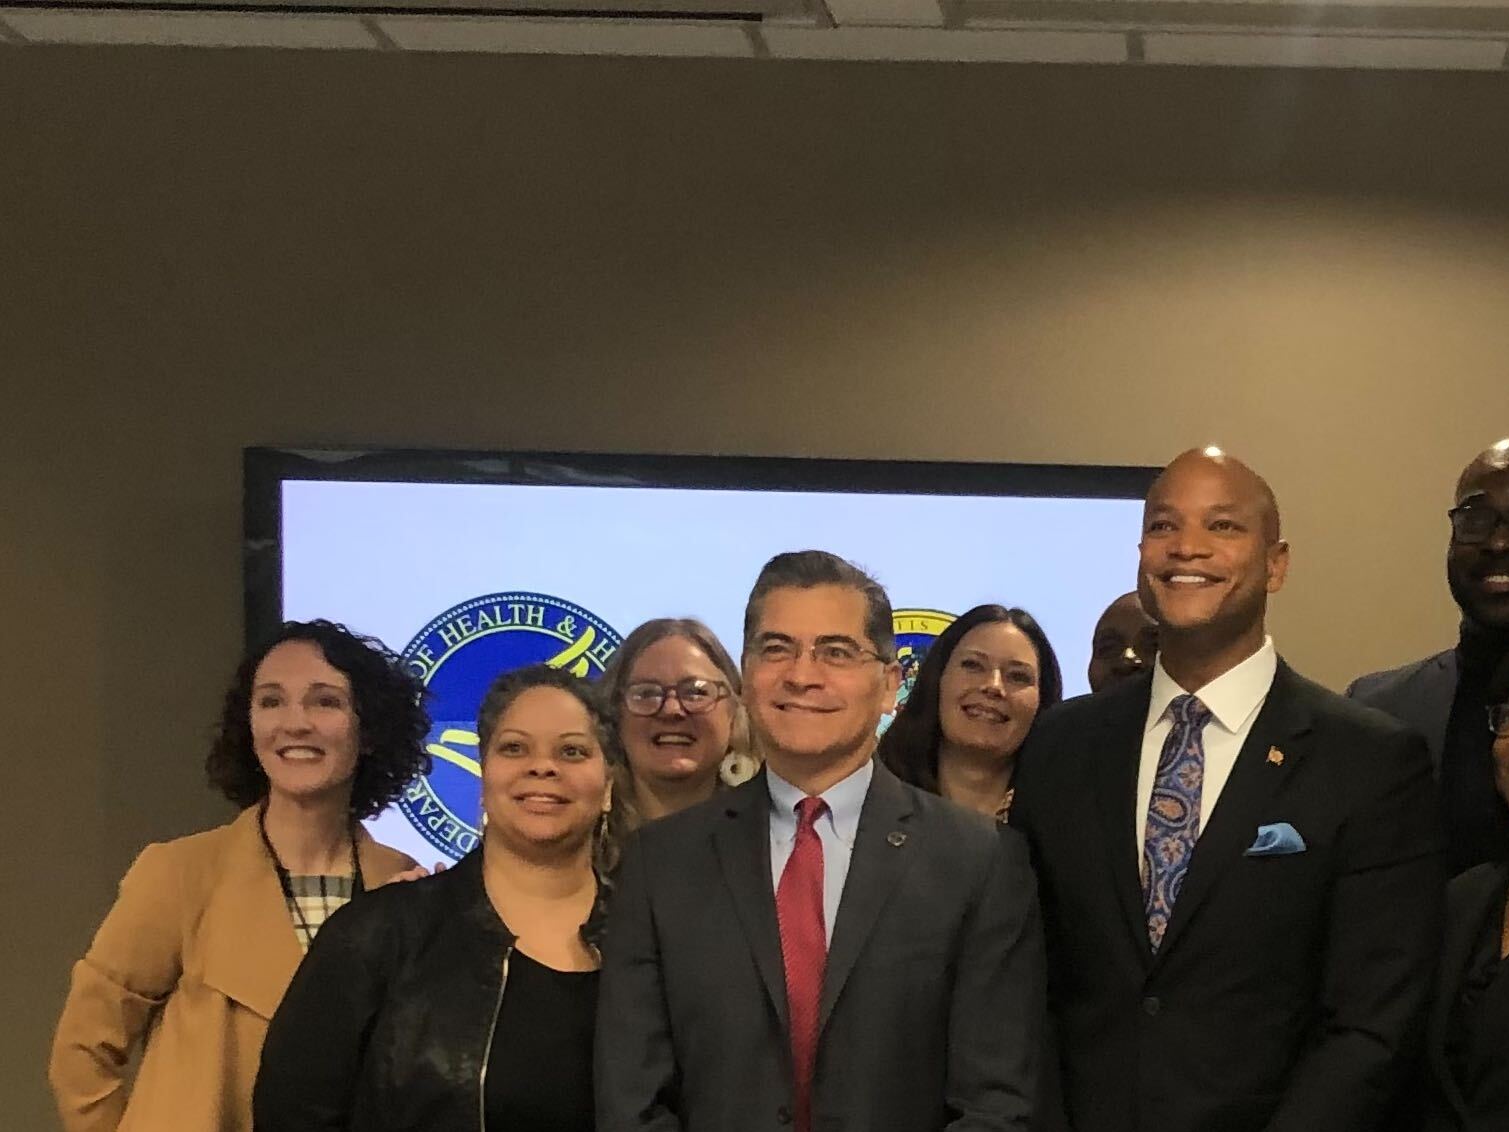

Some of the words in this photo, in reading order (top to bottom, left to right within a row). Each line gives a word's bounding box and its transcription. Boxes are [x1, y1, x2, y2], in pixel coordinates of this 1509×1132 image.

[437, 603, 545, 647] HEALTH
[556, 614, 577, 638] &
[409, 643, 435, 679] OF
[406, 781, 479, 853] DEPAR
